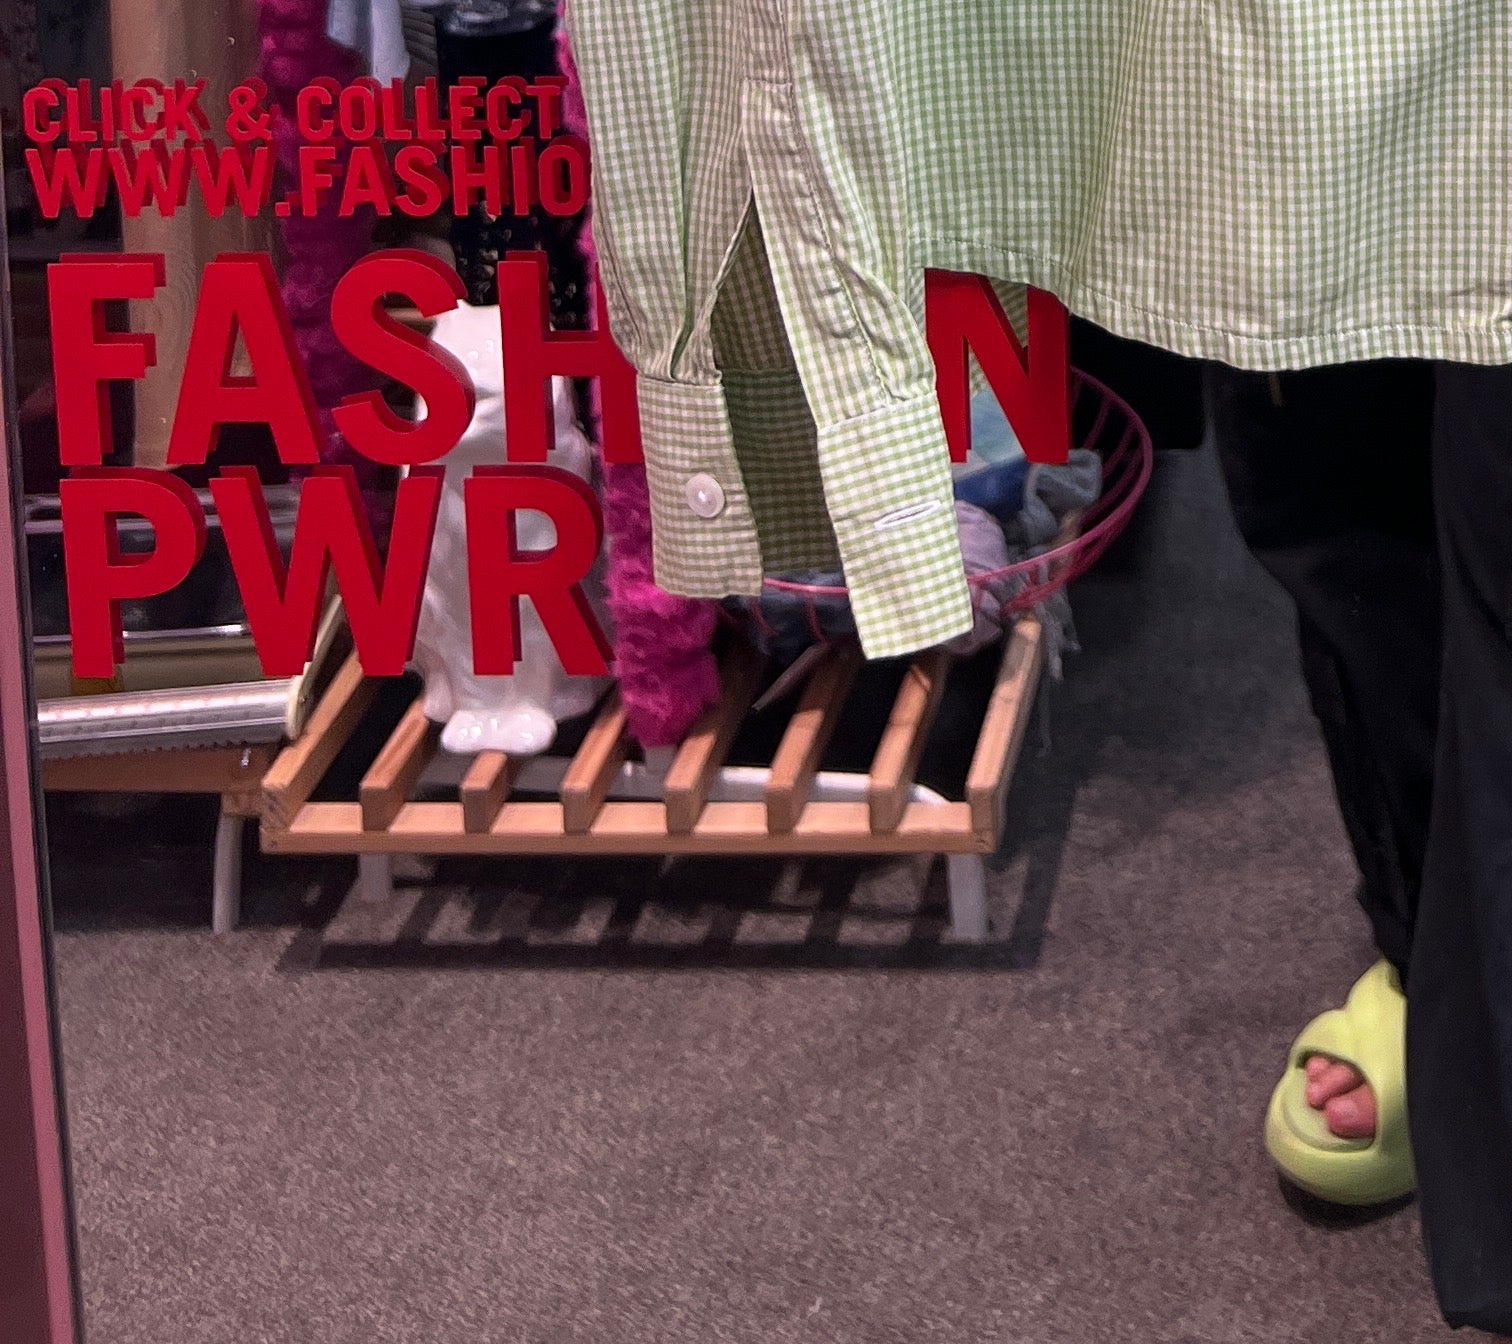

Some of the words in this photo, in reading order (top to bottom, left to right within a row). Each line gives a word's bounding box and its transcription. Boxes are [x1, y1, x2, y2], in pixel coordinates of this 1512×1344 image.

[23, 84, 200, 143] CLICK
[226, 85, 273, 141] &
[297, 84, 562, 141] COLLECT
[24, 144, 587, 218] WWW.FASHIO
[46, 262, 1070, 464] FASHN
[60, 476, 611, 678] PWR
